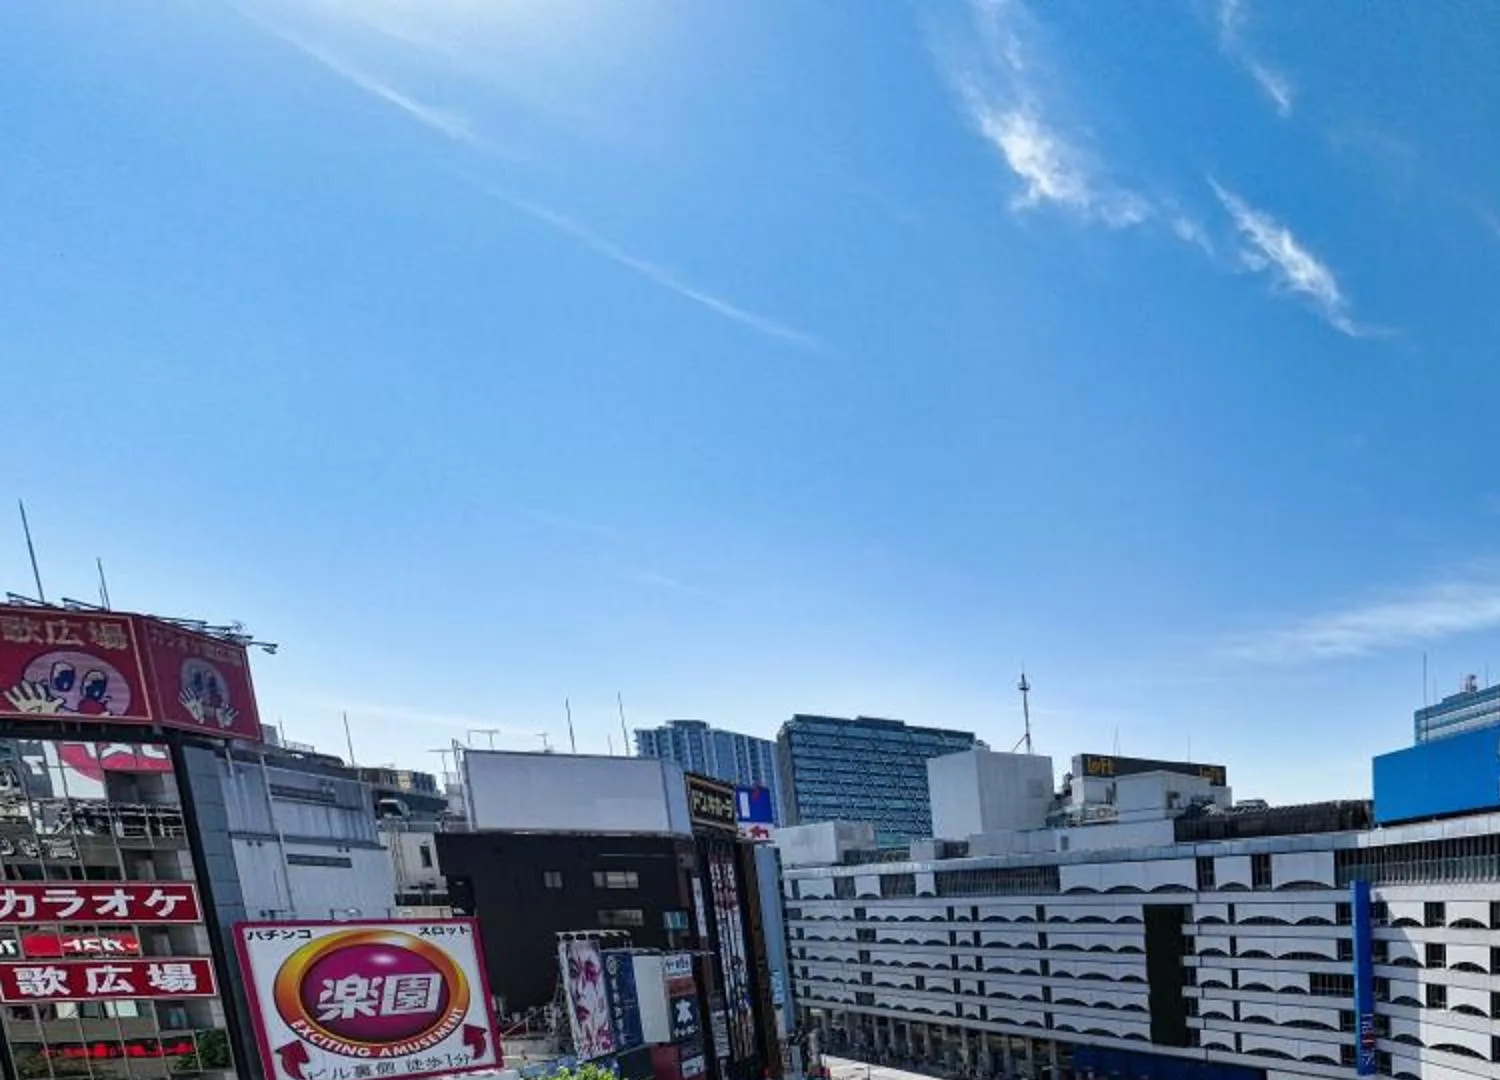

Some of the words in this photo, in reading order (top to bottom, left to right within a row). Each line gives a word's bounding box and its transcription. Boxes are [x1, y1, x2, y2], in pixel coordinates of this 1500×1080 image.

[0, 888, 187, 917] カラオケ
[247, 928, 313, 941] パチンコ
[419, 925, 472, 937] スロット
[13, 963, 198, 997] 歌広場
[317, 972, 442, 1021] 楽園
[290, 1018, 371, 1057] EXCITING
[379, 1006, 465, 1058] AMUSEMENT
[406, 1053, 471, 1074] 徒歩1分
